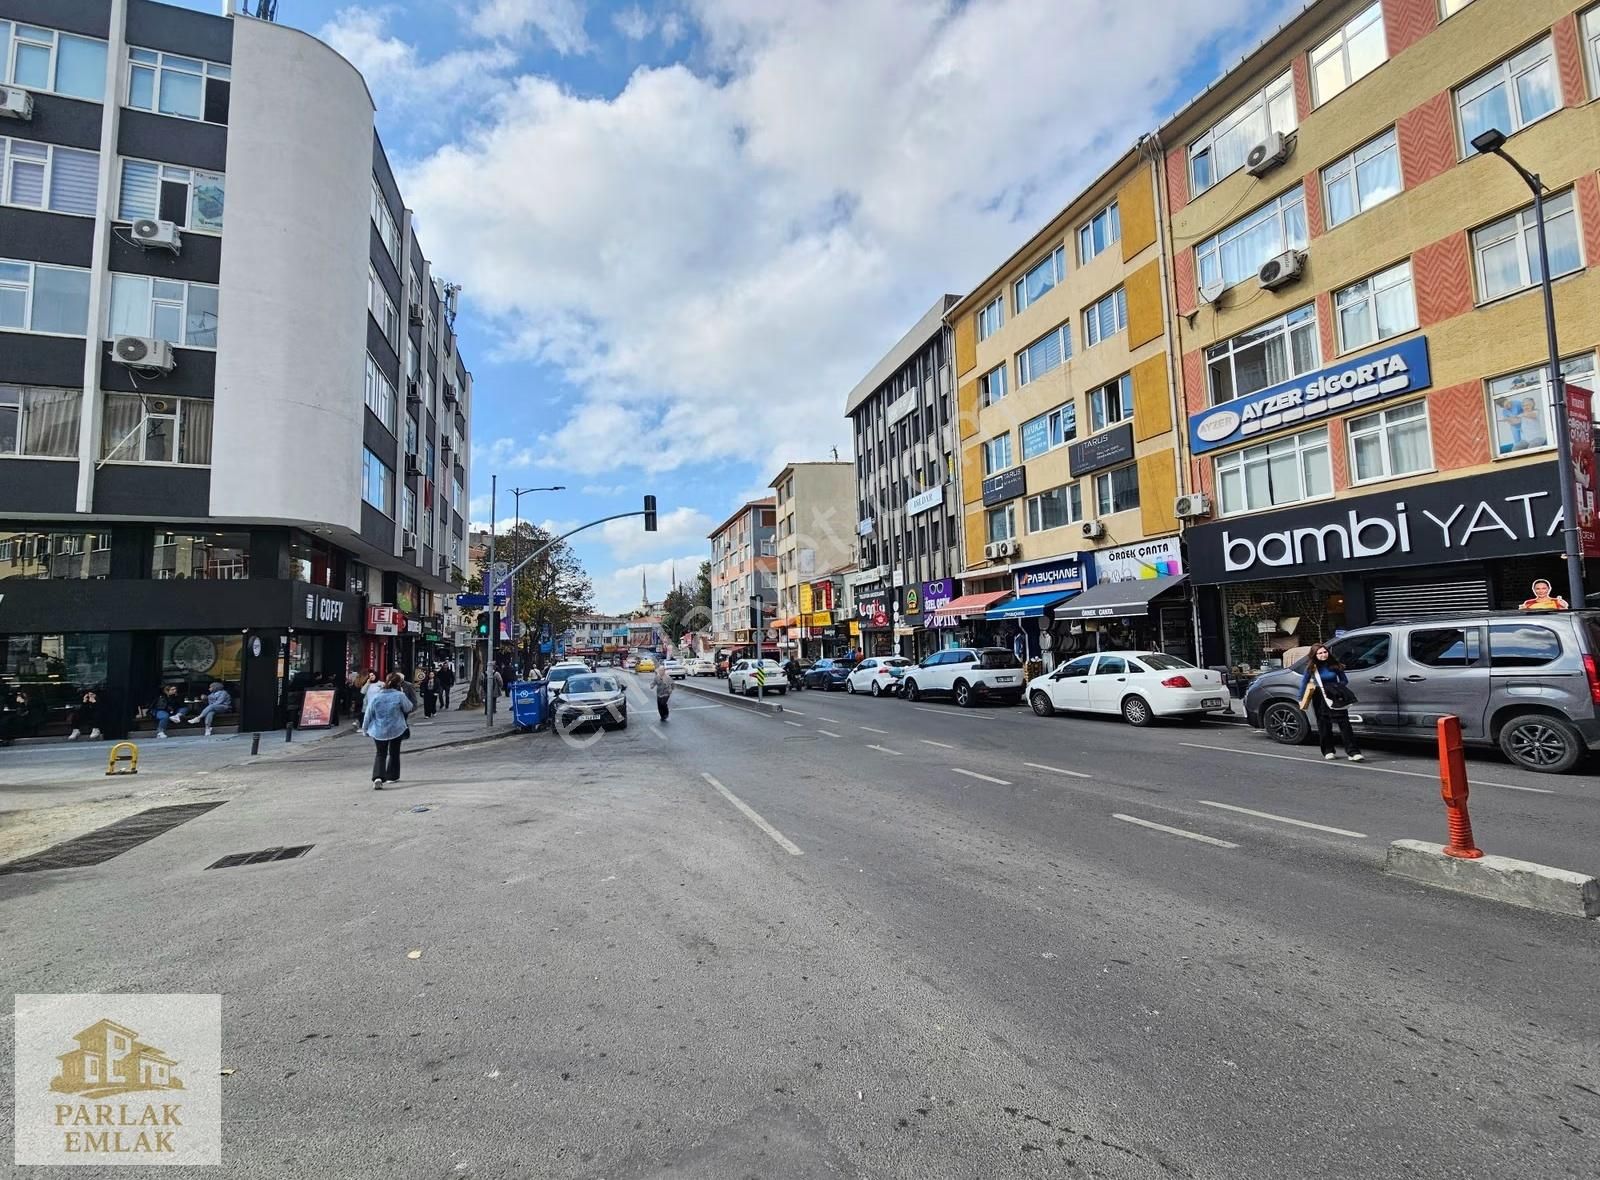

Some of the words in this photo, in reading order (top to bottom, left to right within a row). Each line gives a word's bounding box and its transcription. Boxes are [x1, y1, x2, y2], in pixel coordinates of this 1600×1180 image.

[1240, 388, 1304, 423] AYZER
[1304, 353, 1409, 401] SİGORTA
[1200, 415, 1234, 434] AYZER
[1222, 502, 1411, 572] bambi
[1108, 549, 1137, 562] ÖRNEK
[1138, 542, 1169, 557] ÇANTA
[1027, 566, 1079, 584] PABUÇHANE
[320, 598, 343, 623] COFFY
[924, 596, 937, 610] ÖZEL
[377, 608, 388, 621] E
